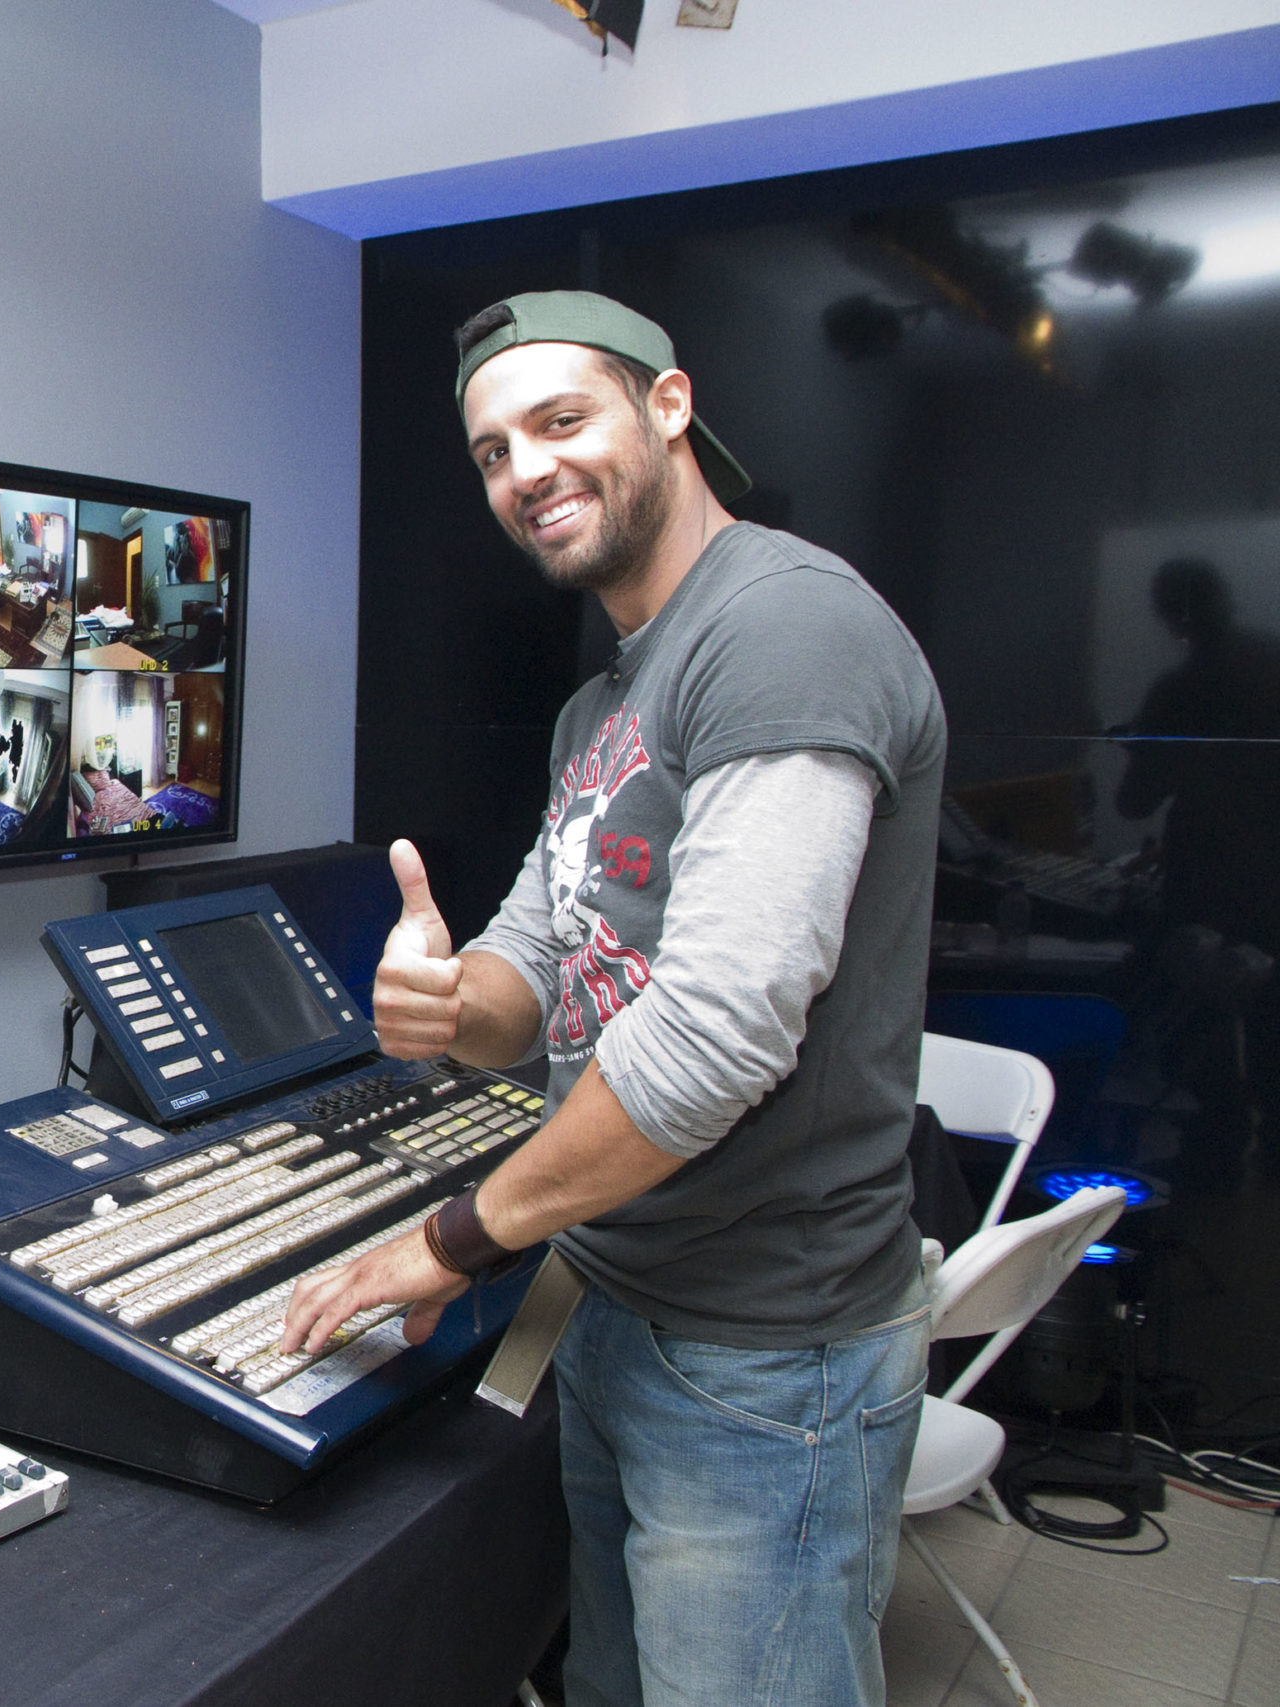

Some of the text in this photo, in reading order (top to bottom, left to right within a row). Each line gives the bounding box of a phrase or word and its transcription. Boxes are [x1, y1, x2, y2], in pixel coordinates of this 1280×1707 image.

[161, 660, 169, 672] 2
[132, 819, 162, 832] UMD 4
